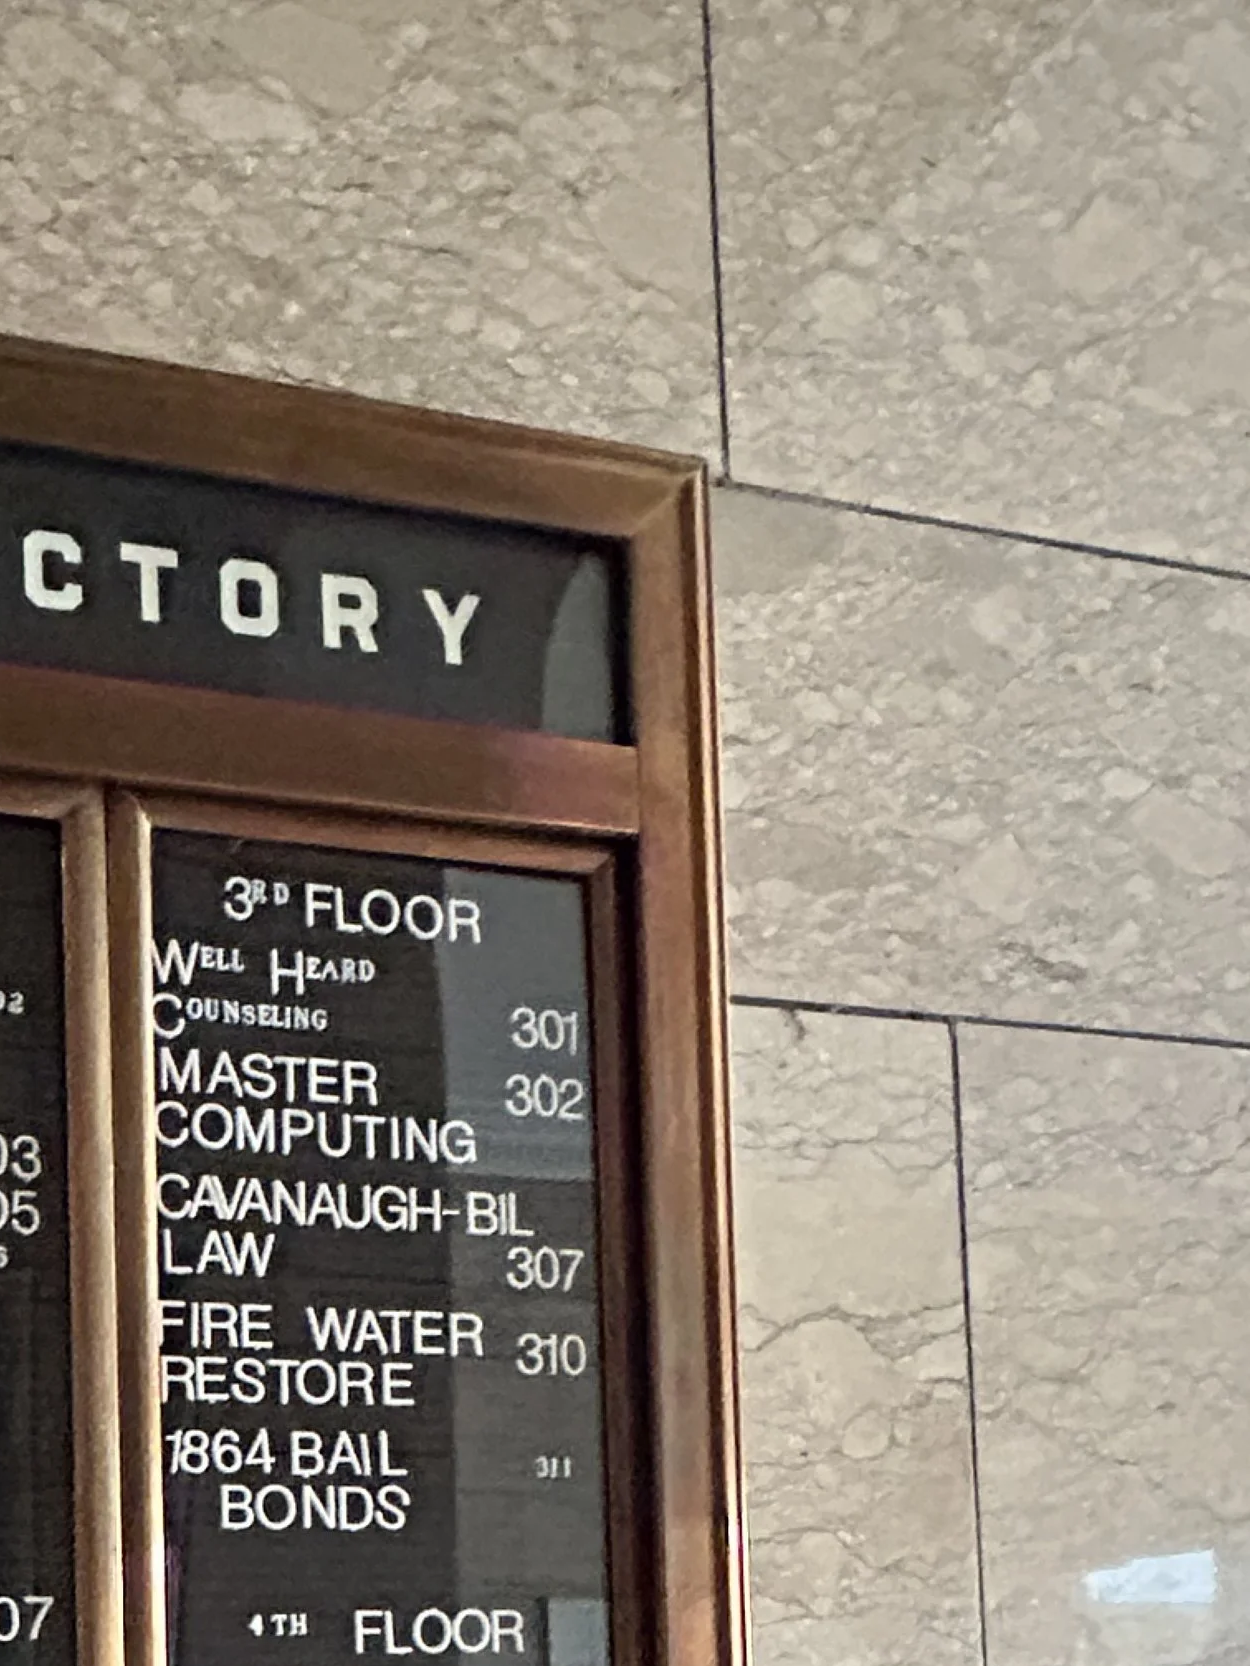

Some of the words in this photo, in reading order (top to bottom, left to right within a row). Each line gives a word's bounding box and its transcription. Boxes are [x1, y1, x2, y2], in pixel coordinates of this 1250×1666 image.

[305, 884, 481, 944] FLOOR
[510, 1006, 578, 1055] 301
[159, 1048, 379, 1106] MASTER
[505, 1073, 585, 1121] 302
[156, 1100, 478, 1164] COMPUTING
[157, 1173, 535, 1237] CAVANAUGH-BIL
[162, 1230, 275, 1278] LAW
[506, 1246, 584, 1291] 307
[158, 1299, 273, 1351] FIRE
[307, 1306, 484, 1357] WATER
[515, 1333, 587, 1377] 310
[161, 1355, 414, 1407] RESTORE
[165, 1428, 275, 1475] 1864
[291, 1429, 408, 1480] BAIL
[220, 1484, 411, 1531] BONDS
[354, 1608, 524, 1656] FLOOR
